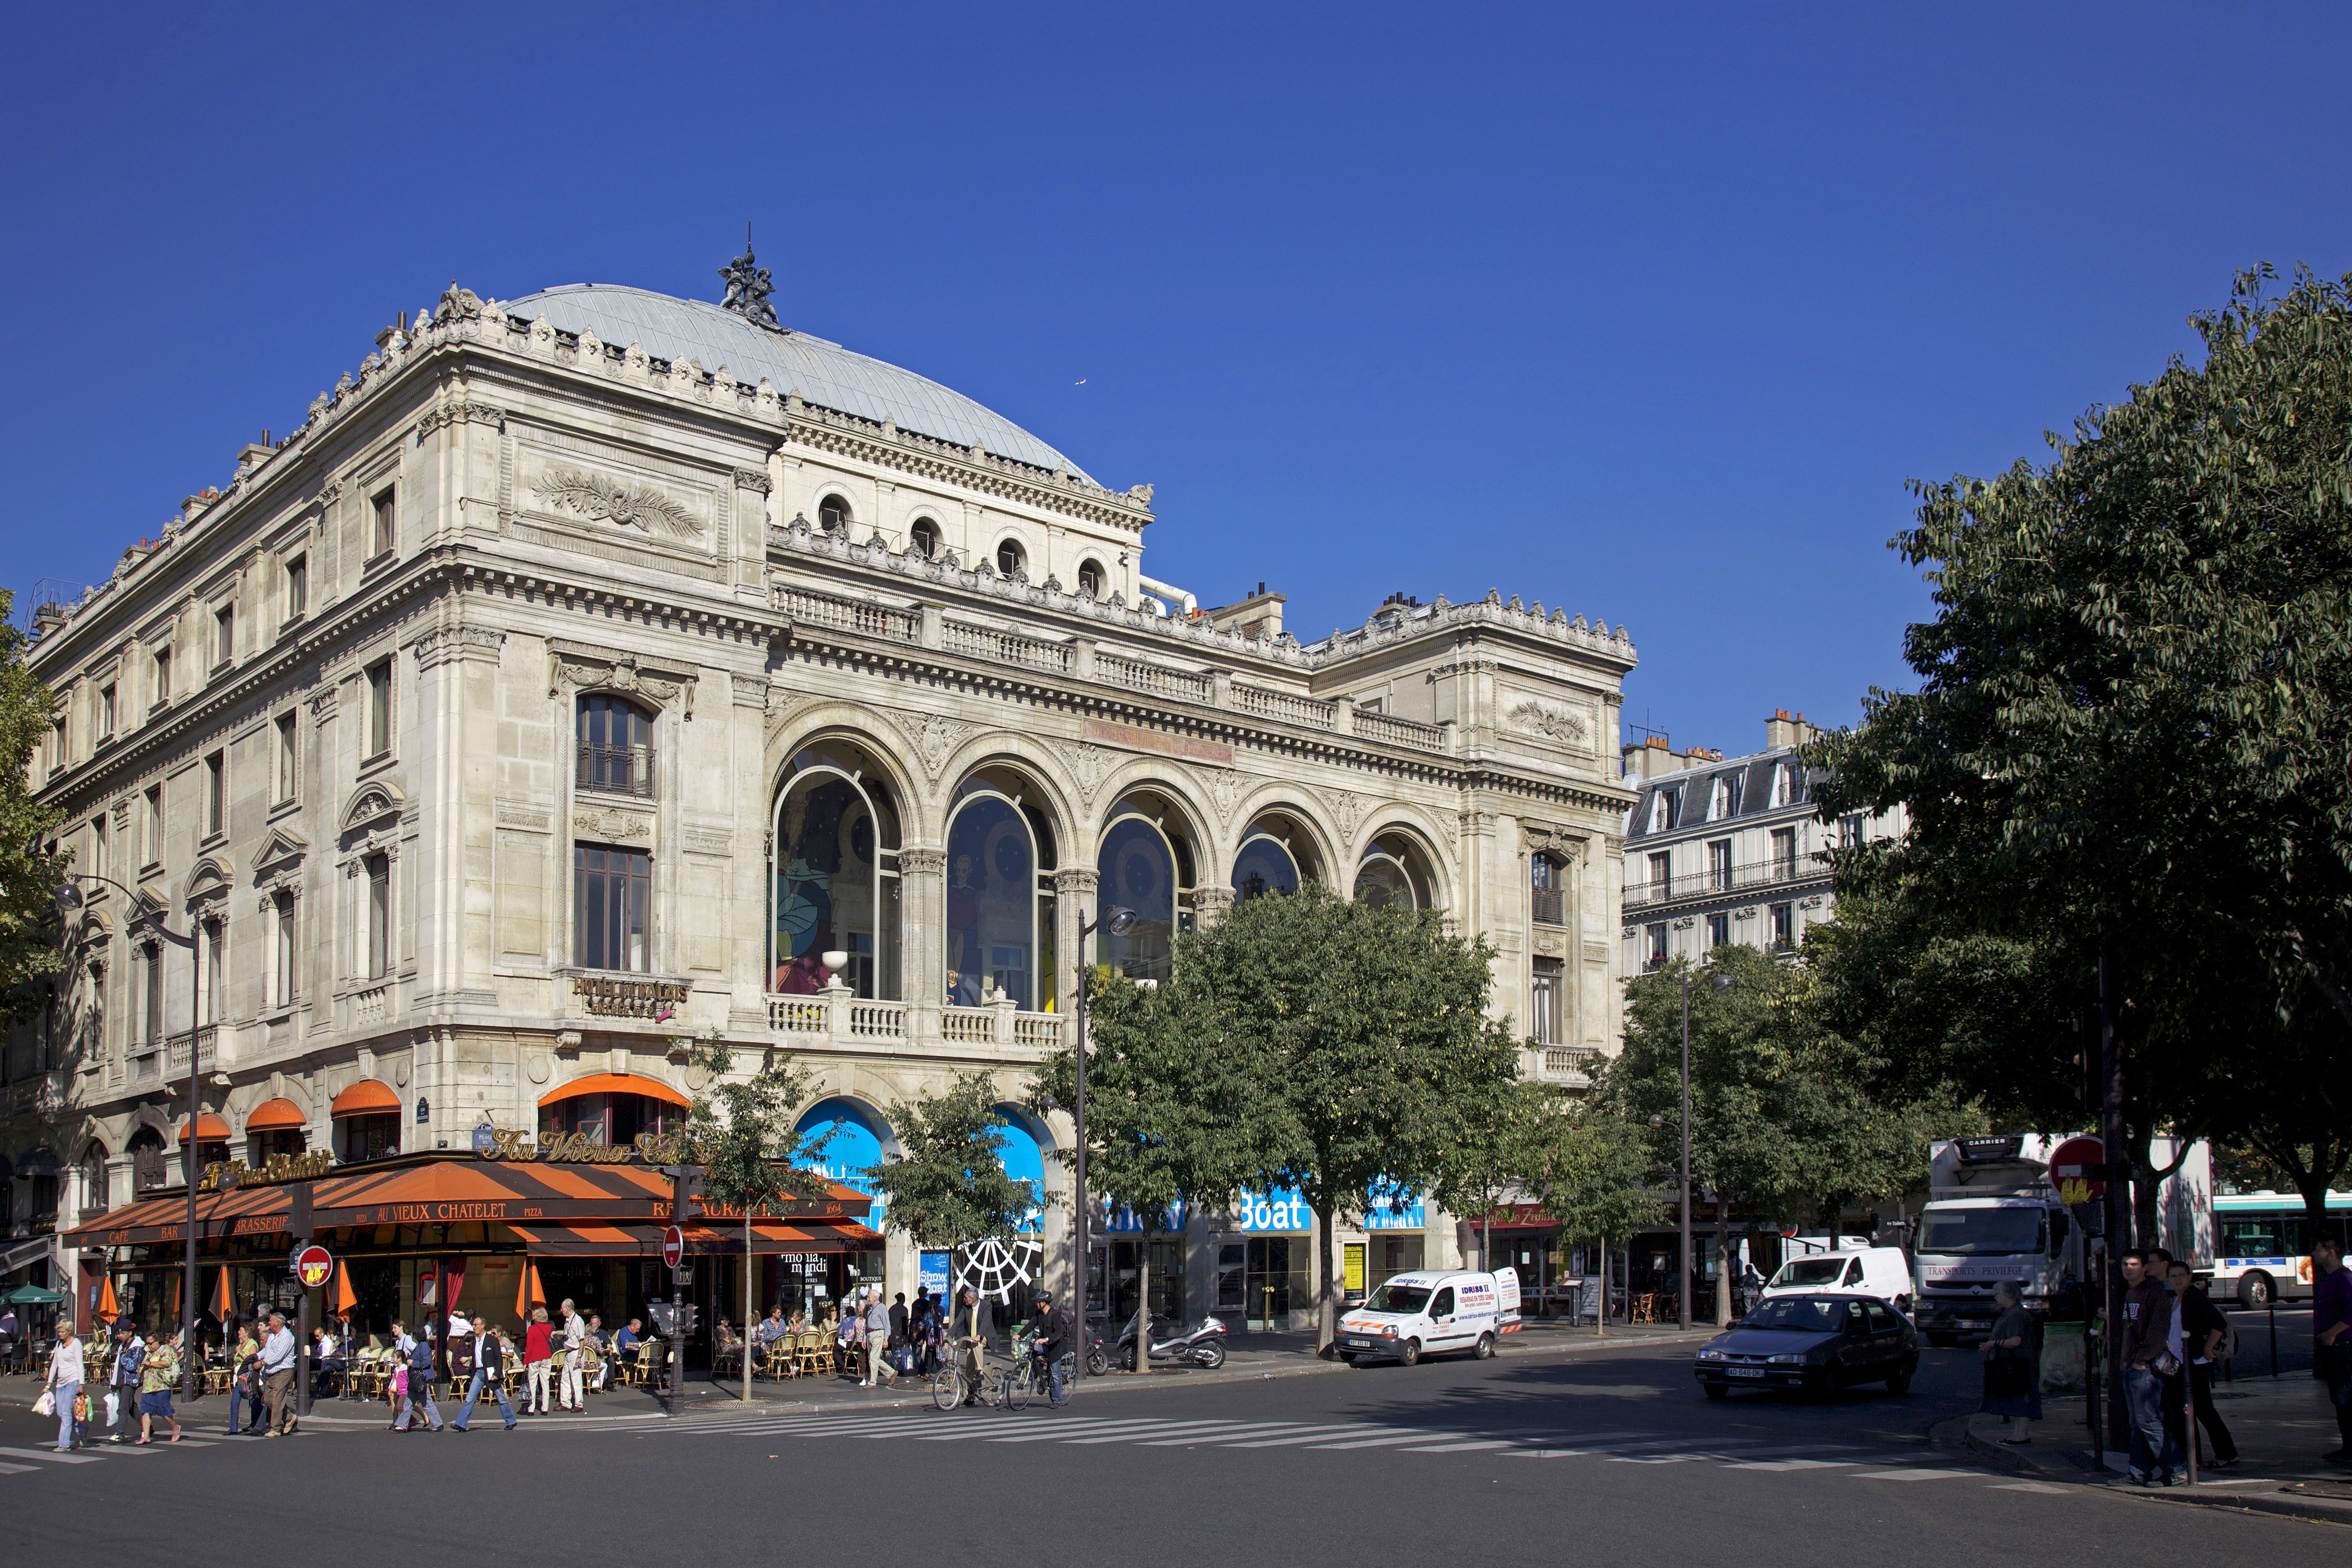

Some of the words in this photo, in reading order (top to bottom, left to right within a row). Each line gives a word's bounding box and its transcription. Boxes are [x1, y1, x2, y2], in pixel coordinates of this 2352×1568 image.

[575, 977, 619, 995] HOTEL
[638, 982, 688, 1001] PALAIS
[482, 1128, 539, 1161] Au
[539, 1130, 632, 1163] Vieux
[377, 1207, 388, 1221] AU
[392, 1204, 430, 1220] VIEUX
[438, 1203, 506, 1219] CHATELET
[524, 1208, 542, 1217] PIZZA
[1242, 1192, 1302, 1229] Boat
[356, 1214, 367, 1223] PIZZA
[161, 1226, 178, 1239] BAR
[921, 1270, 947, 1282] Show
[1928, 1266, 1975, 1275] TRANSPORTS
[1982, 1266, 2023, 1275] PRIVILEGE
[925, 1282, 947, 1293] Boat
[1461, 1285, 1483, 1294] IDRISS
[1458, 1310, 1498, 1320] www.idriss-debarras.com
